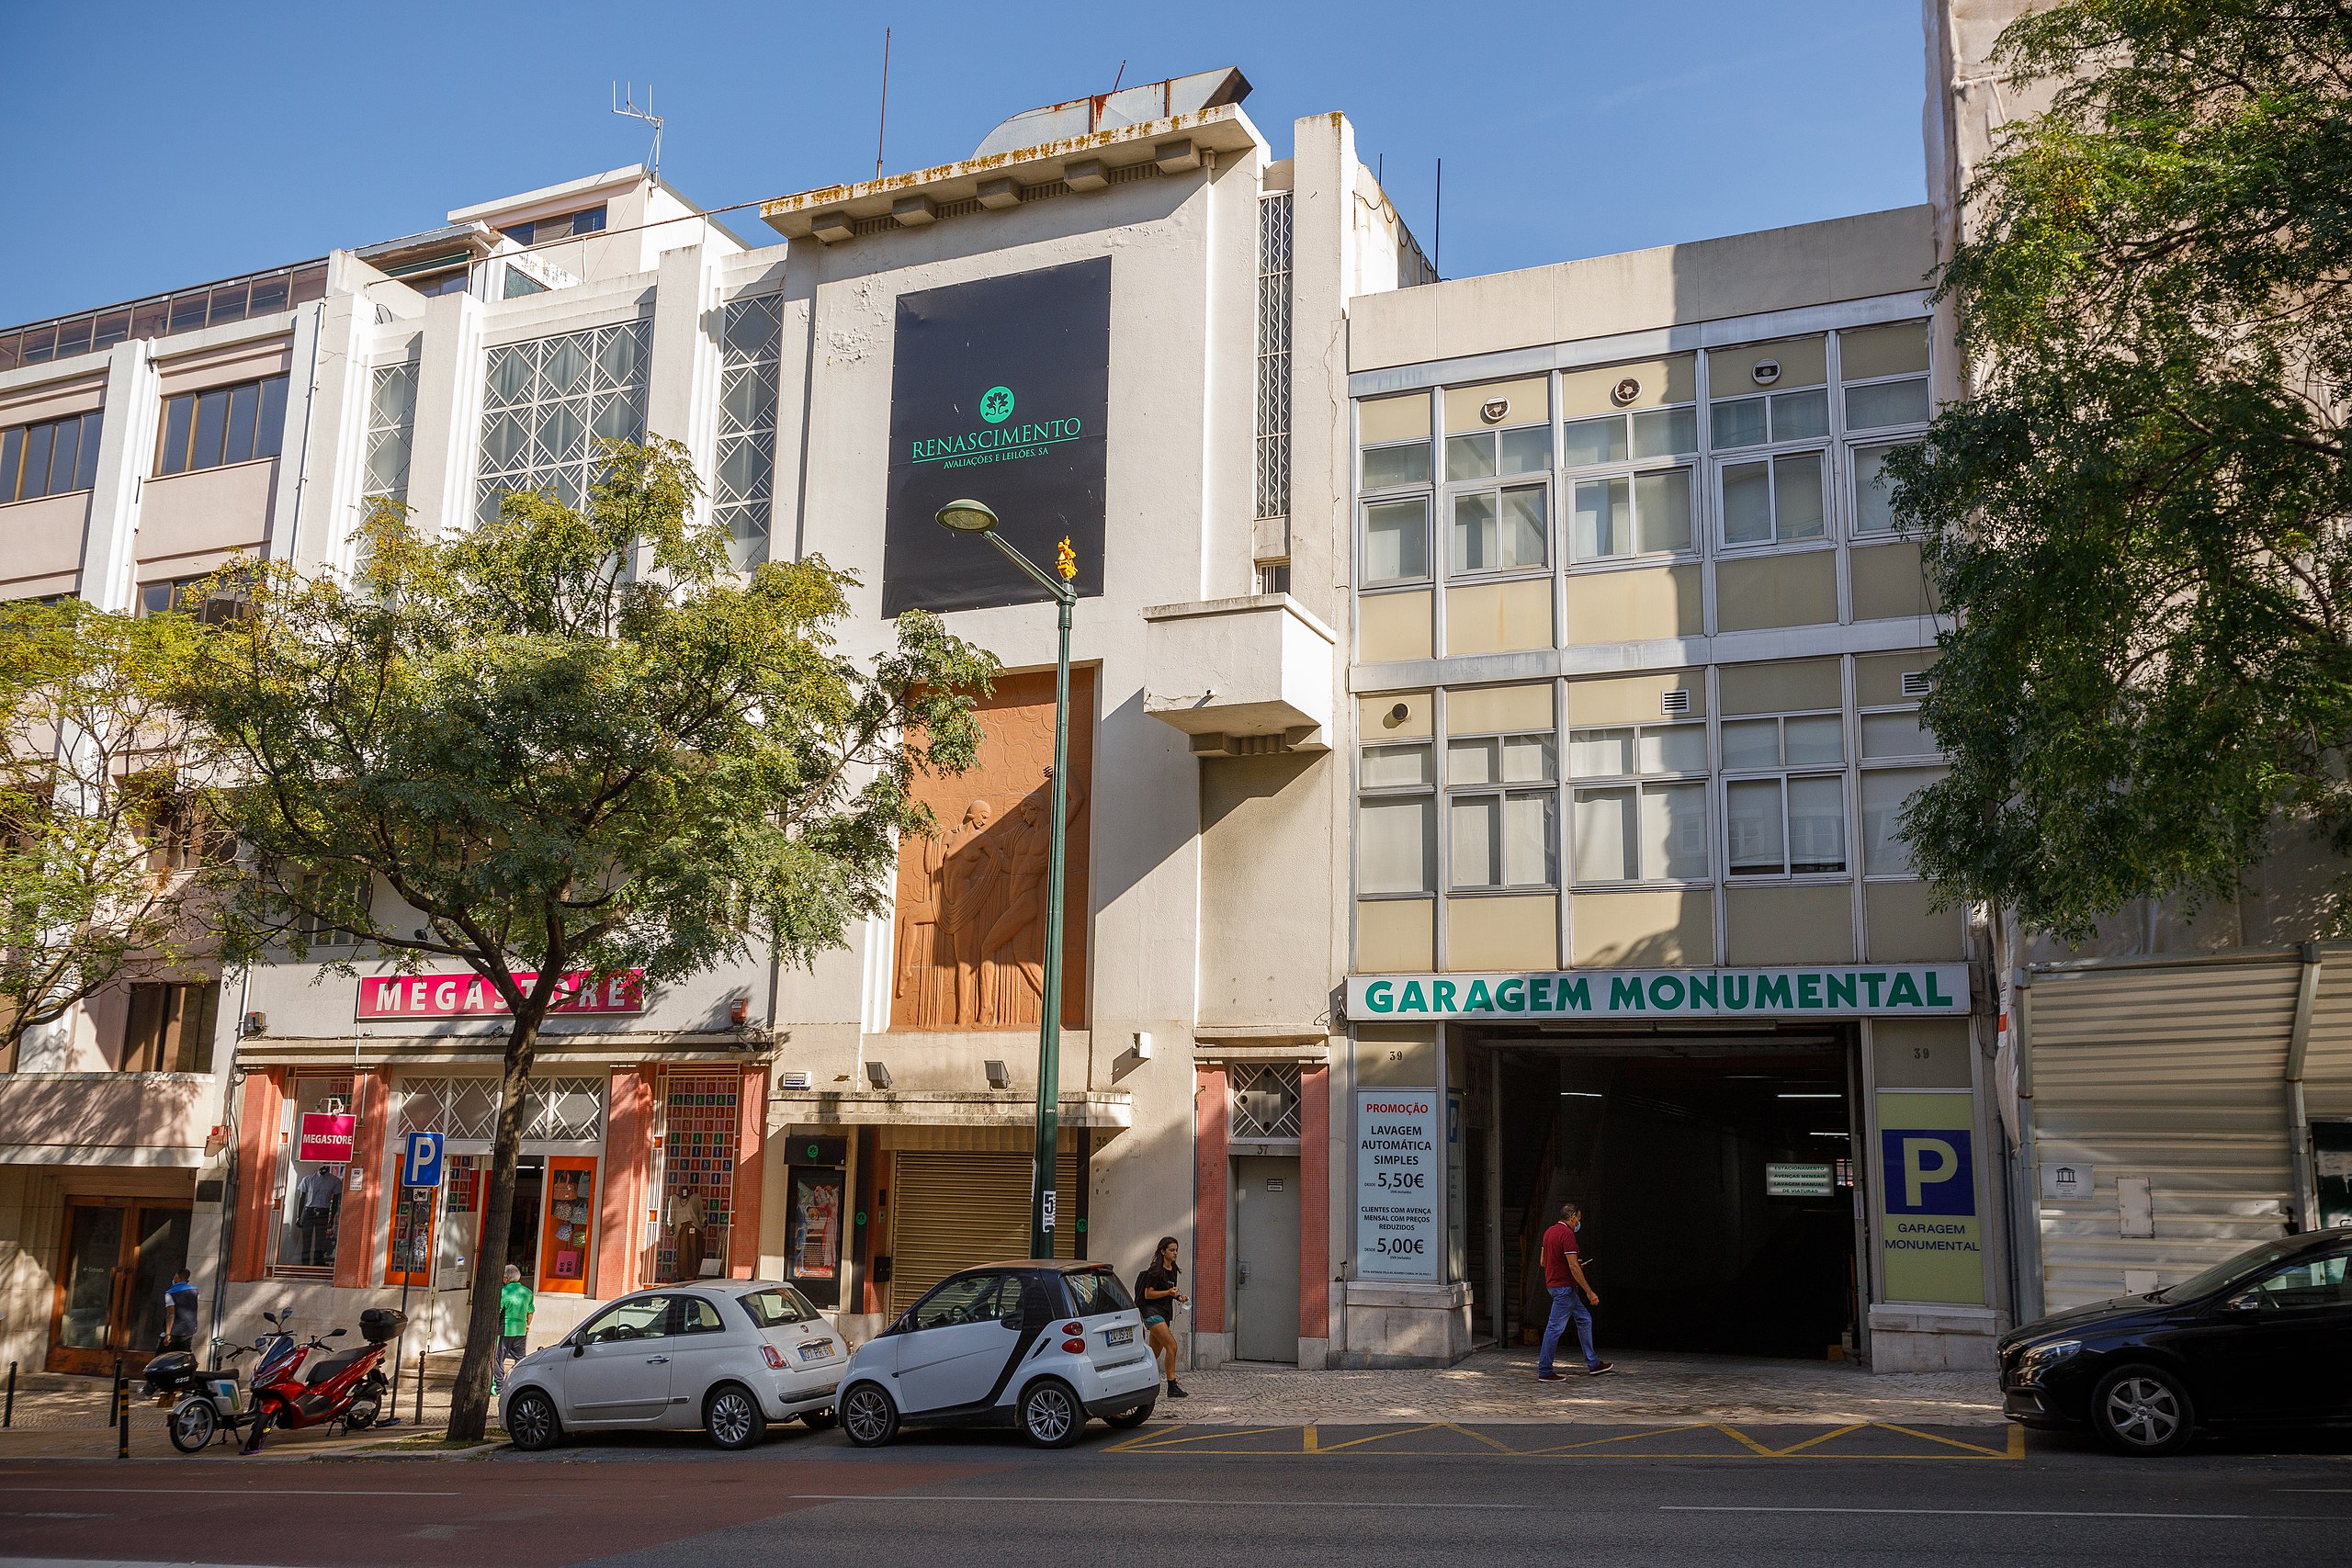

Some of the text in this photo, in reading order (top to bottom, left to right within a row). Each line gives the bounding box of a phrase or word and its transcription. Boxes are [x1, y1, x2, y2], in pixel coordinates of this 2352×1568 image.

[911, 417, 1082, 458] RENASCIMENTO
[944, 446, 1049, 469] AVALIAÇÕES E LEILÕES, SA
[1364, 971, 1953, 1013] GARAGEM MONUMENTAL
[1389, 1051, 1403, 1061] 39
[1914, 1048, 1929, 1059] 39
[1366, 1102, 1429, 1116] PROMOÇÃO
[1371, 1125, 1422, 1135] LAVAGEM
[302, 1134, 353, 1145] MEGASTORE
[1095, 1136, 1108, 1147] 35
[1361, 1139, 1432, 1151] AUTOMÁTICA
[1257, 1145, 1269, 1155] 37
[412, 1136, 436, 1181] P
[1374, 1155, 1419, 1166] SIMPLES
[1903, 1137, 1959, 1207] P
[1377, 1172, 1425, 1190] 5,50€
[1407, 1207, 1432, 1215] AVENÇA
[1897, 1223, 1966, 1235] GARAGEM
[1376, 1237, 1425, 1256] 5,00€
[1884, 1239, 1981, 1252] MONUMENTAL
